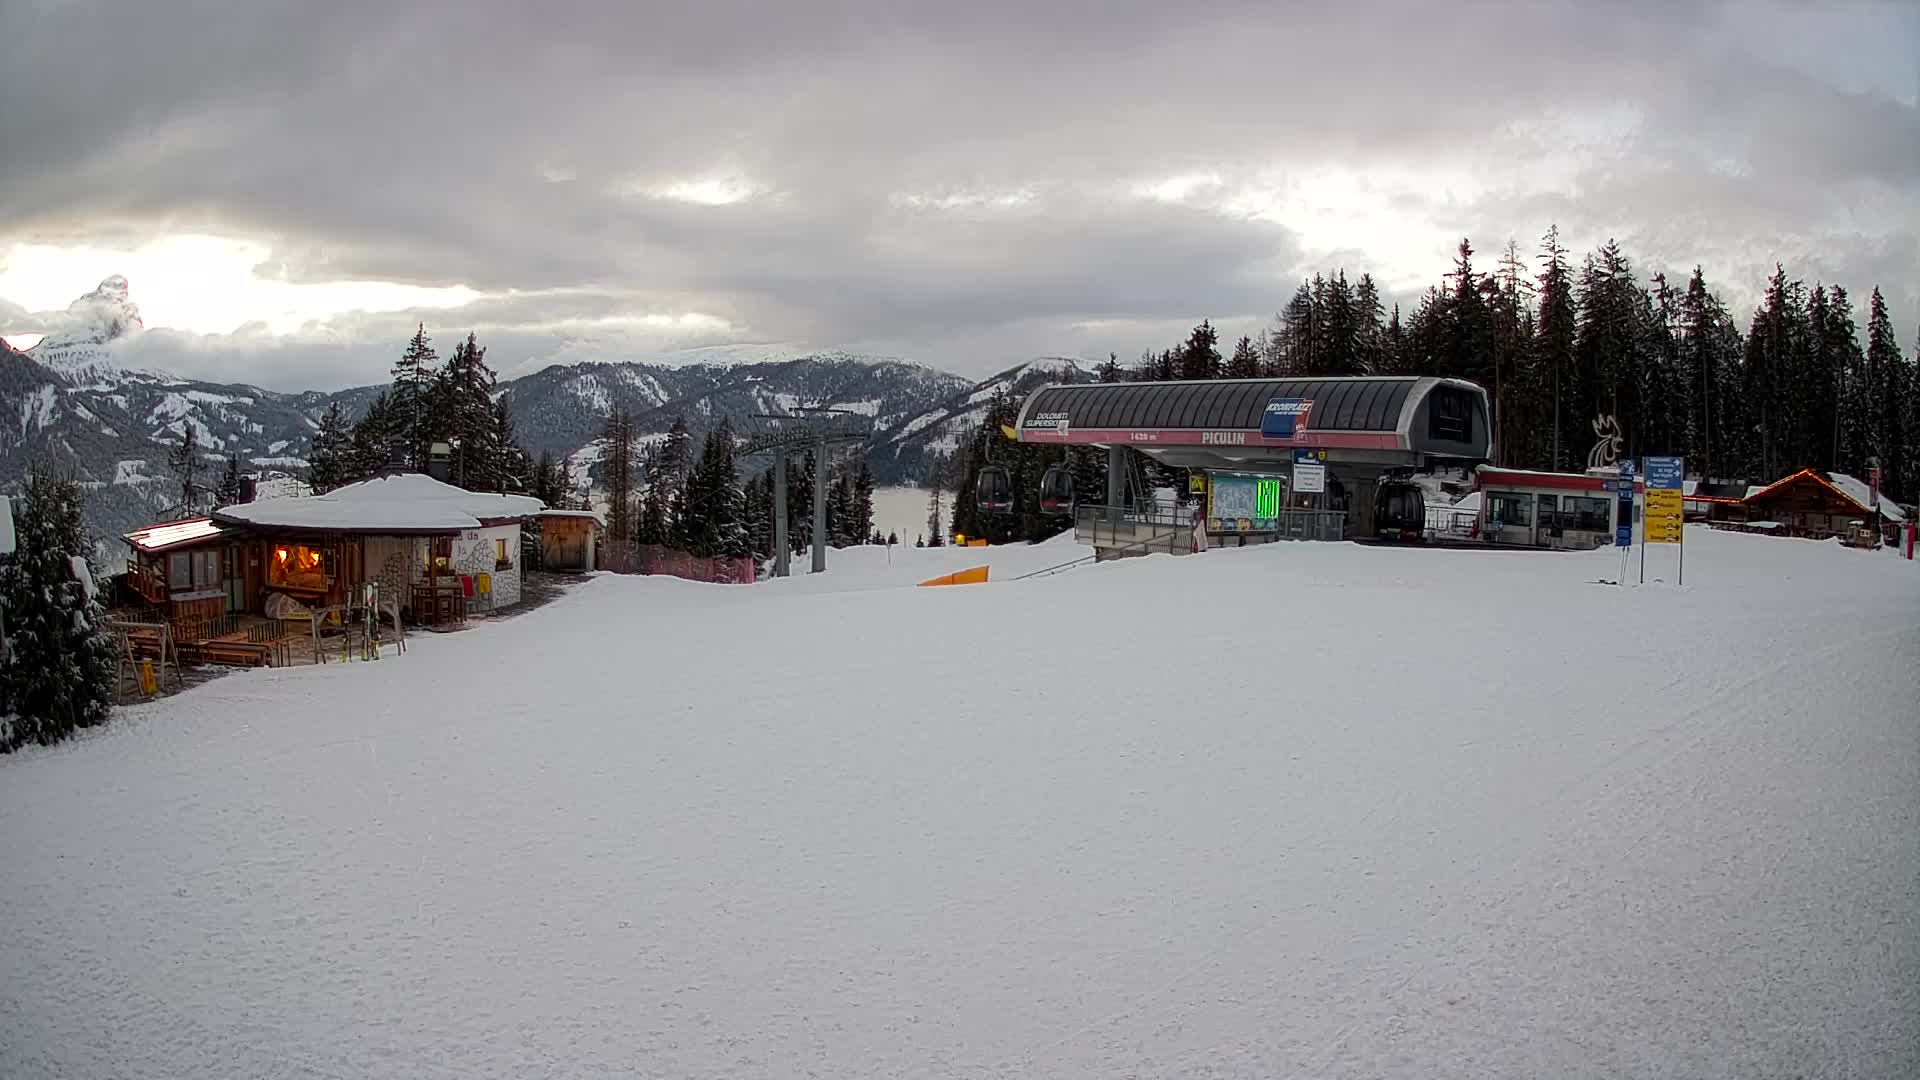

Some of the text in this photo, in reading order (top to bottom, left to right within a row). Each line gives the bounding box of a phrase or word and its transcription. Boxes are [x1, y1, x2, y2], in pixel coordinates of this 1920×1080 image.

[1036, 412, 1069, 420] DOLOMITI
[1025, 419, 1059, 427] SUPERSKI
[1202, 431, 1245, 445] PICULIN
